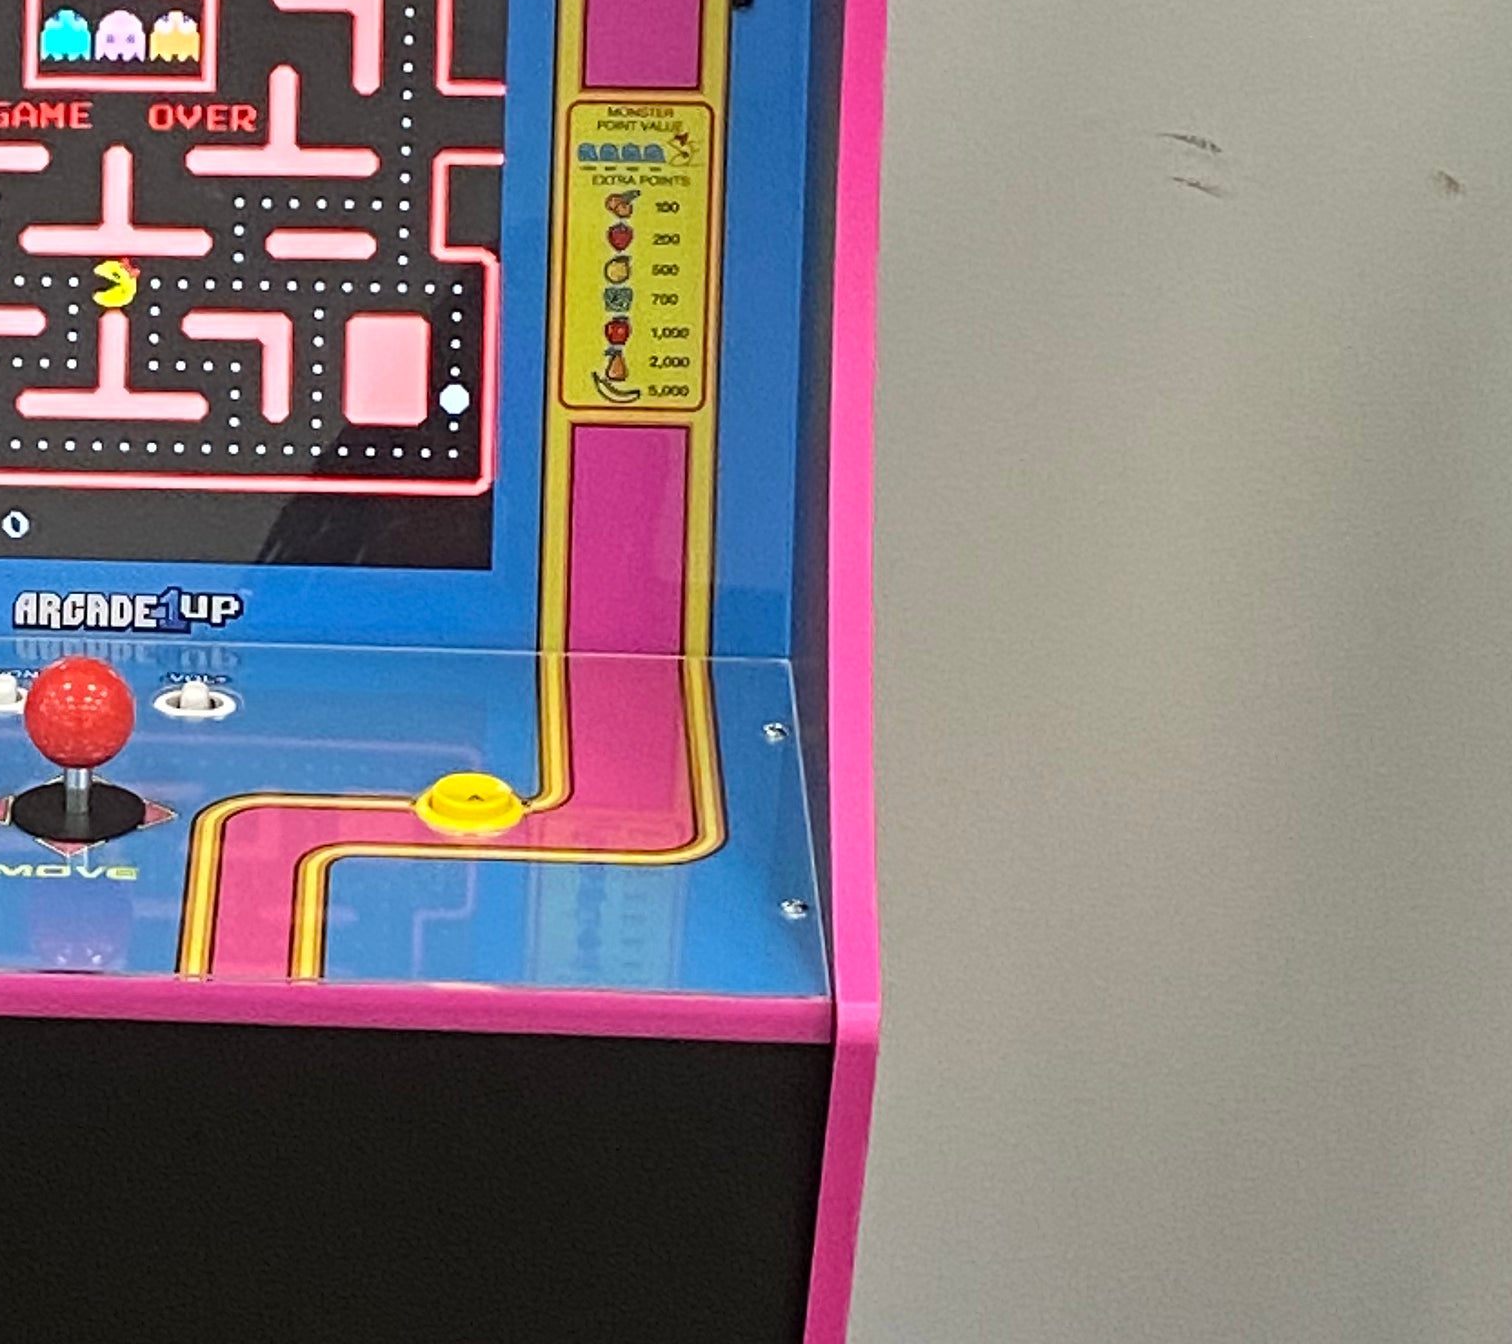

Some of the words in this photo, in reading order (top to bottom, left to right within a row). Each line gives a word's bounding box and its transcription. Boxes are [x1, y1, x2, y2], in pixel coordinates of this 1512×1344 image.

[147, 103, 258, 134] OVER
[607, 106, 675, 118] MONSTER
[597, 120, 637, 131] POINT
[640, 120, 683, 132] VALUE
[592, 175, 636, 186] EXTRA
[639, 175, 691, 187] POINTS
[655, 200, 680, 214] 100
[652, 232, 680, 246] 200
[651, 264, 680, 277] 500
[651, 292, 679, 306] 700
[651, 327, 690, 341] 1,000
[648, 355, 690, 369] 2,000
[647, 384, 690, 398] 5,000
